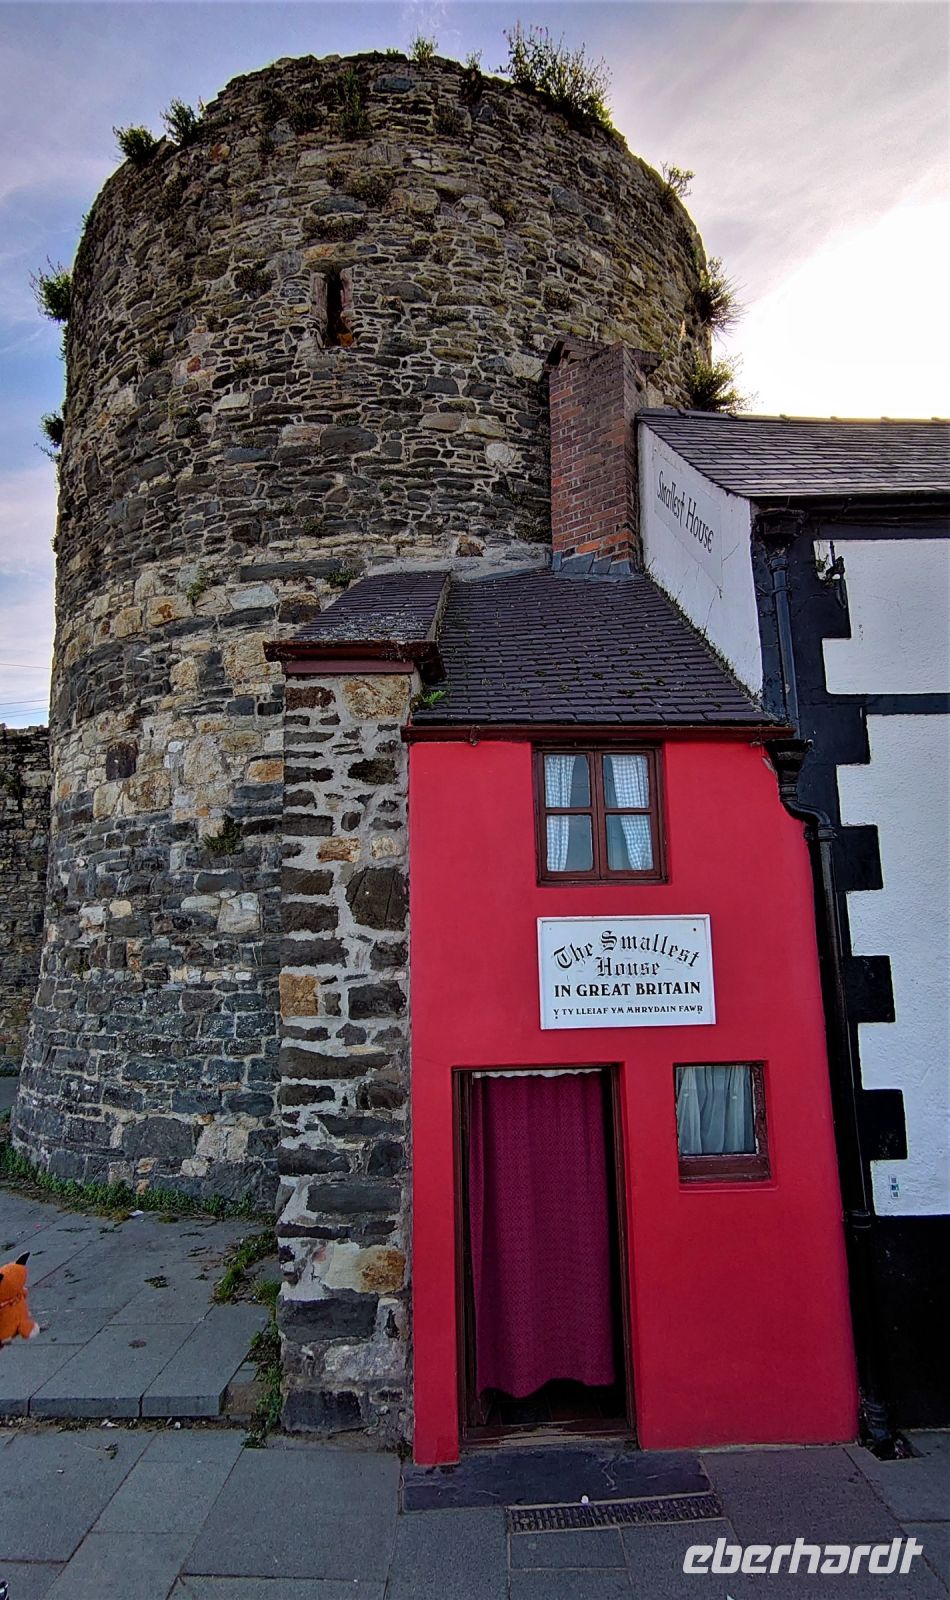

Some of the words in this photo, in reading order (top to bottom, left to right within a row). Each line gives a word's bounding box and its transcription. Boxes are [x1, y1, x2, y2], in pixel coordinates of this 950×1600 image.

[657, 470, 685, 527] Smallest
[553, 942, 593, 969] The
[601, 930, 699, 967] Smallest
[597, 957, 660, 976] House
[554, 985, 571, 997] IN
[576, 983, 631, 997] GREAT
[635, 981, 700, 995] BRITAIN
[576, 1007, 609, 1015] LLEIAF
[626, 1006, 676, 1014] MHRYDAIN
[678, 1005, 703, 1013] FAWR
